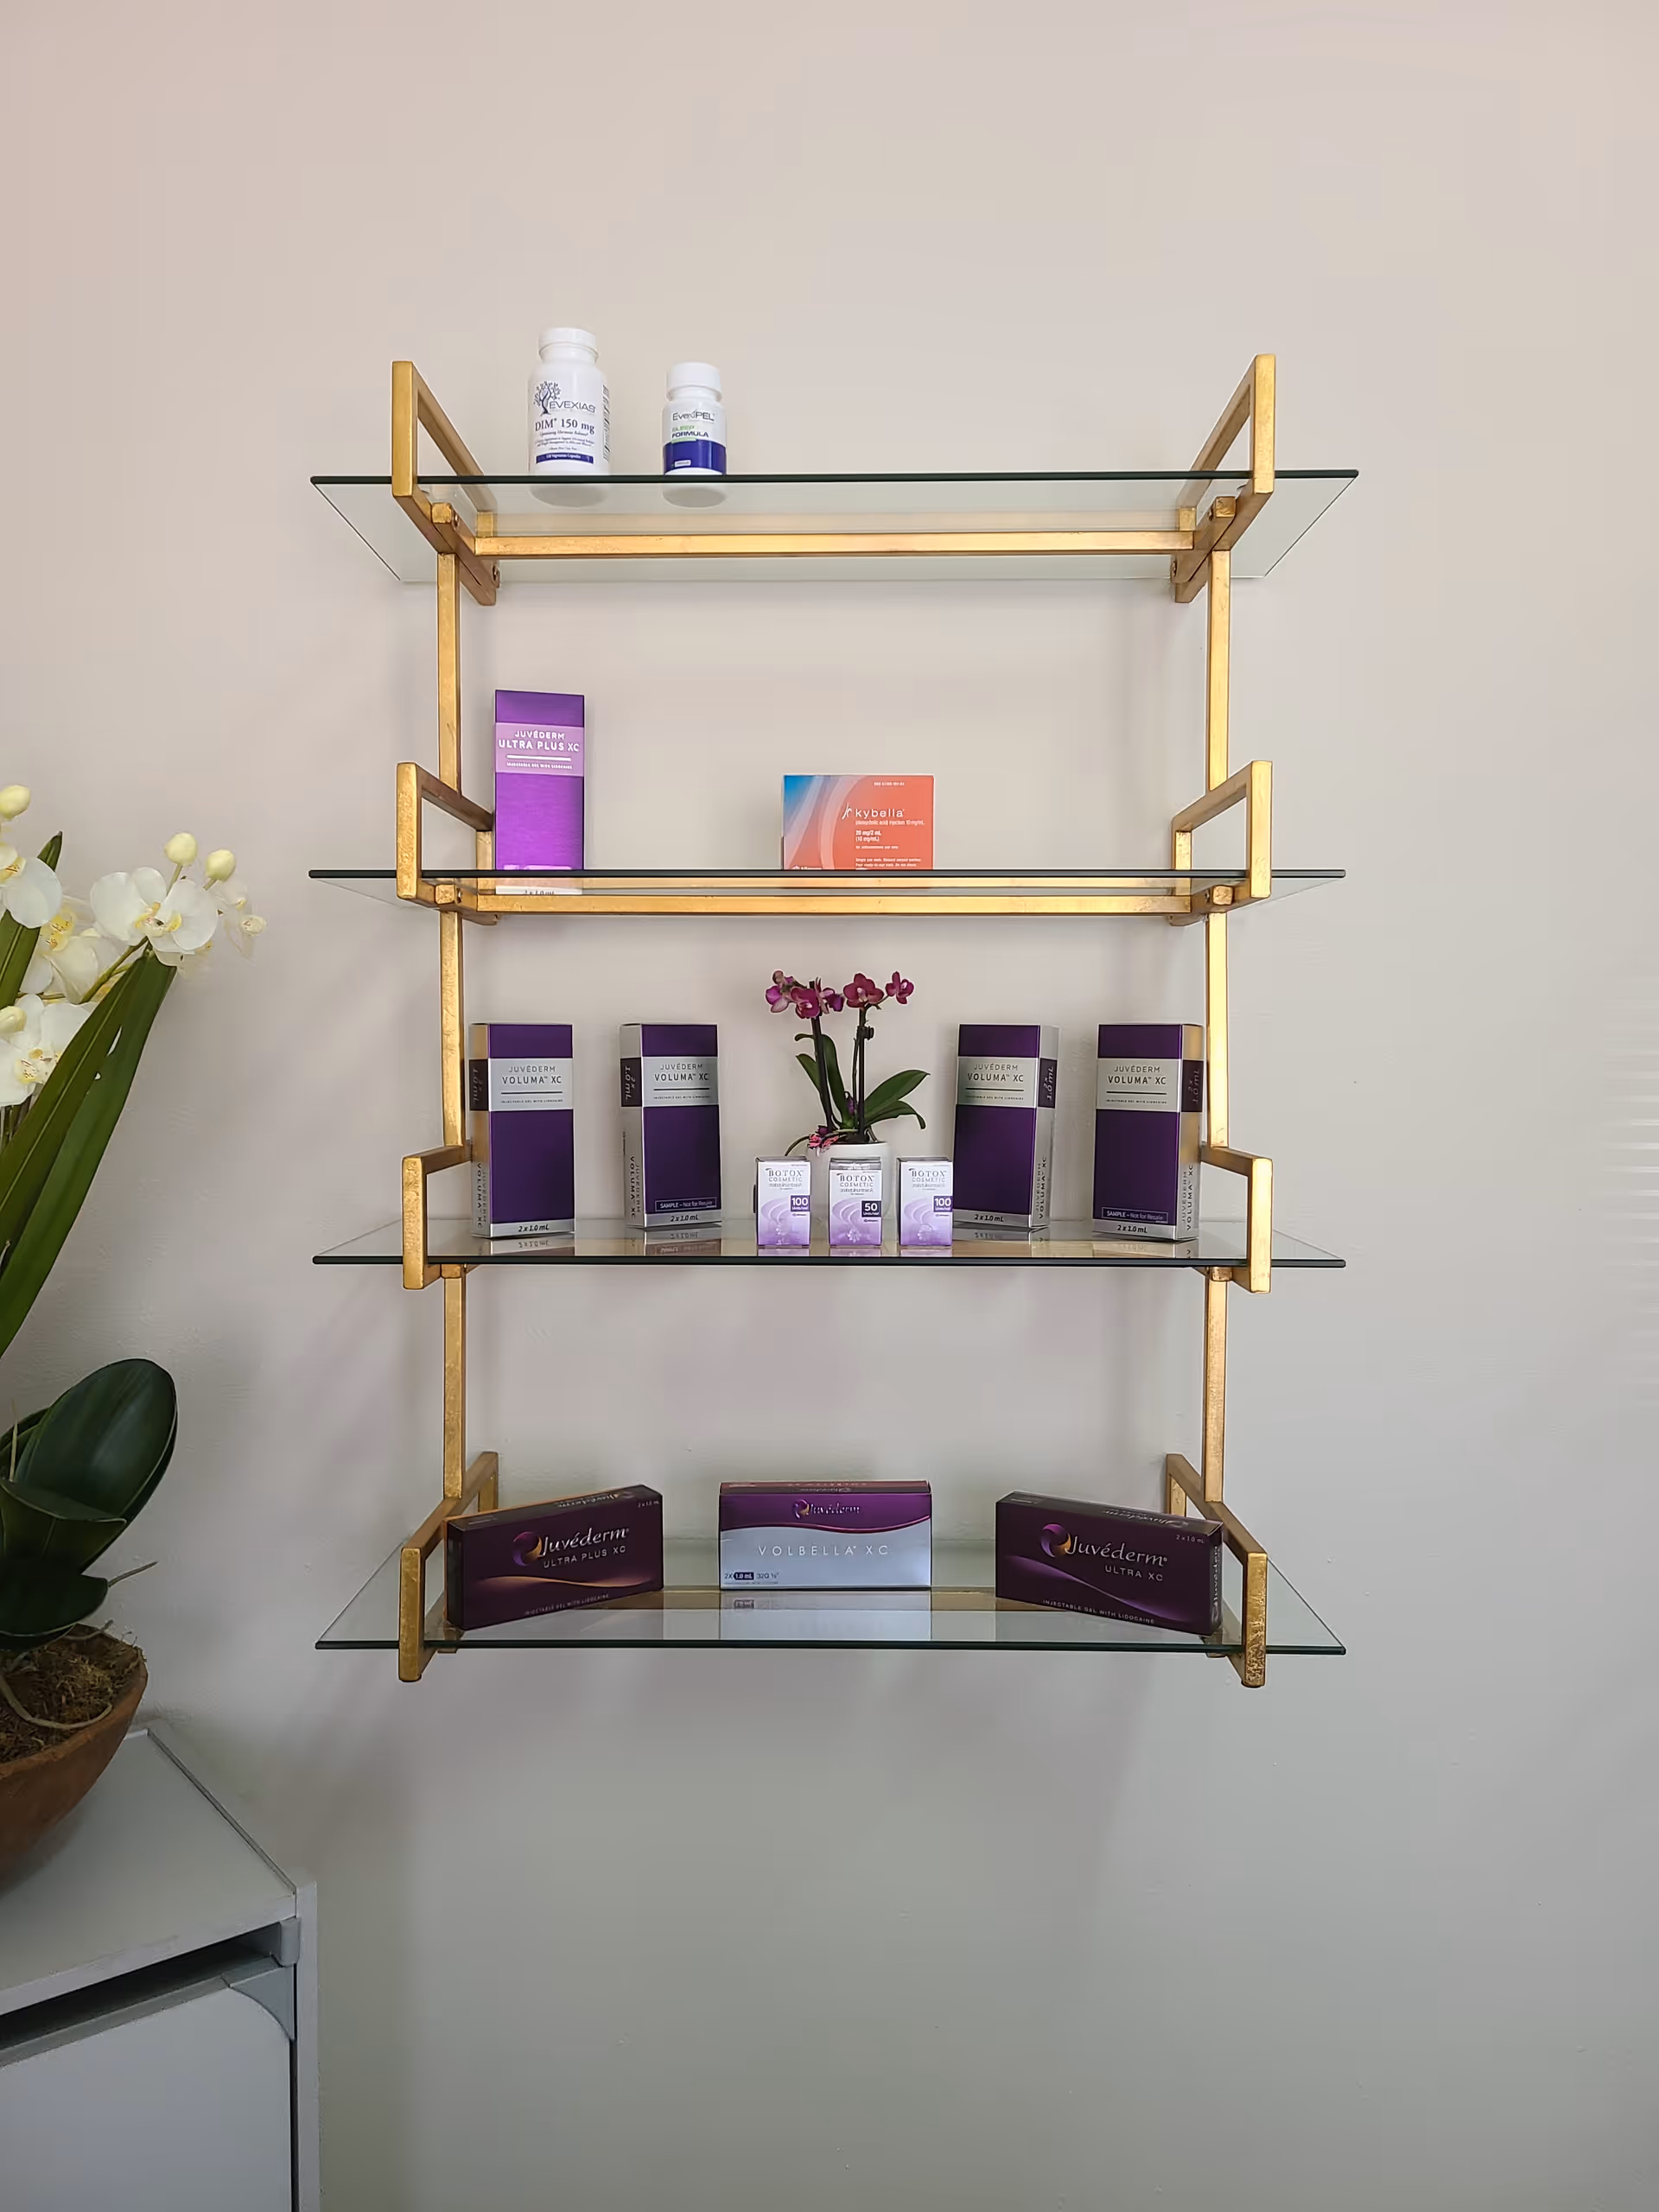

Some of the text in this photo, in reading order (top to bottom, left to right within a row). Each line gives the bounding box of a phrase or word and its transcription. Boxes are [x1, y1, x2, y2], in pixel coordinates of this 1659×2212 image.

[550, 401, 596, 414] EVEXIAS
[562, 419, 578, 428] 150
[582, 423, 594, 435] mg
[514, 729, 565, 741] JUVÉDERM
[499, 740, 580, 752] ULTRA PLUS XC
[1048, 1066, 1054, 1084] mL
[1114, 1065, 1160, 1073] JUVÉDERM
[1154, 1077, 1166, 1085] XC
[1193, 1069, 1199, 1087] mL
[625, 1083, 632, 1101] mL
[1042, 1157, 1046, 1168] XC
[1188, 1165, 1193, 1177] XC
[791, 1197, 809, 1206] 100
[864, 1203, 878, 1211] 50
[934, 1198, 951, 1206] 100
[631, 1207, 636, 1218] XC
[477, 1216, 482, 1229] XC
[866, 1545, 888, 1555] XC
[543, 1545, 626, 1568] ULTRA PLUS XC
[1105, 1565, 1163, 1582] ULTRA XC
[1043, 1599, 1082, 1611] INJECTABLE
[1118, 1613, 1154, 1624] LIDOCAINE
